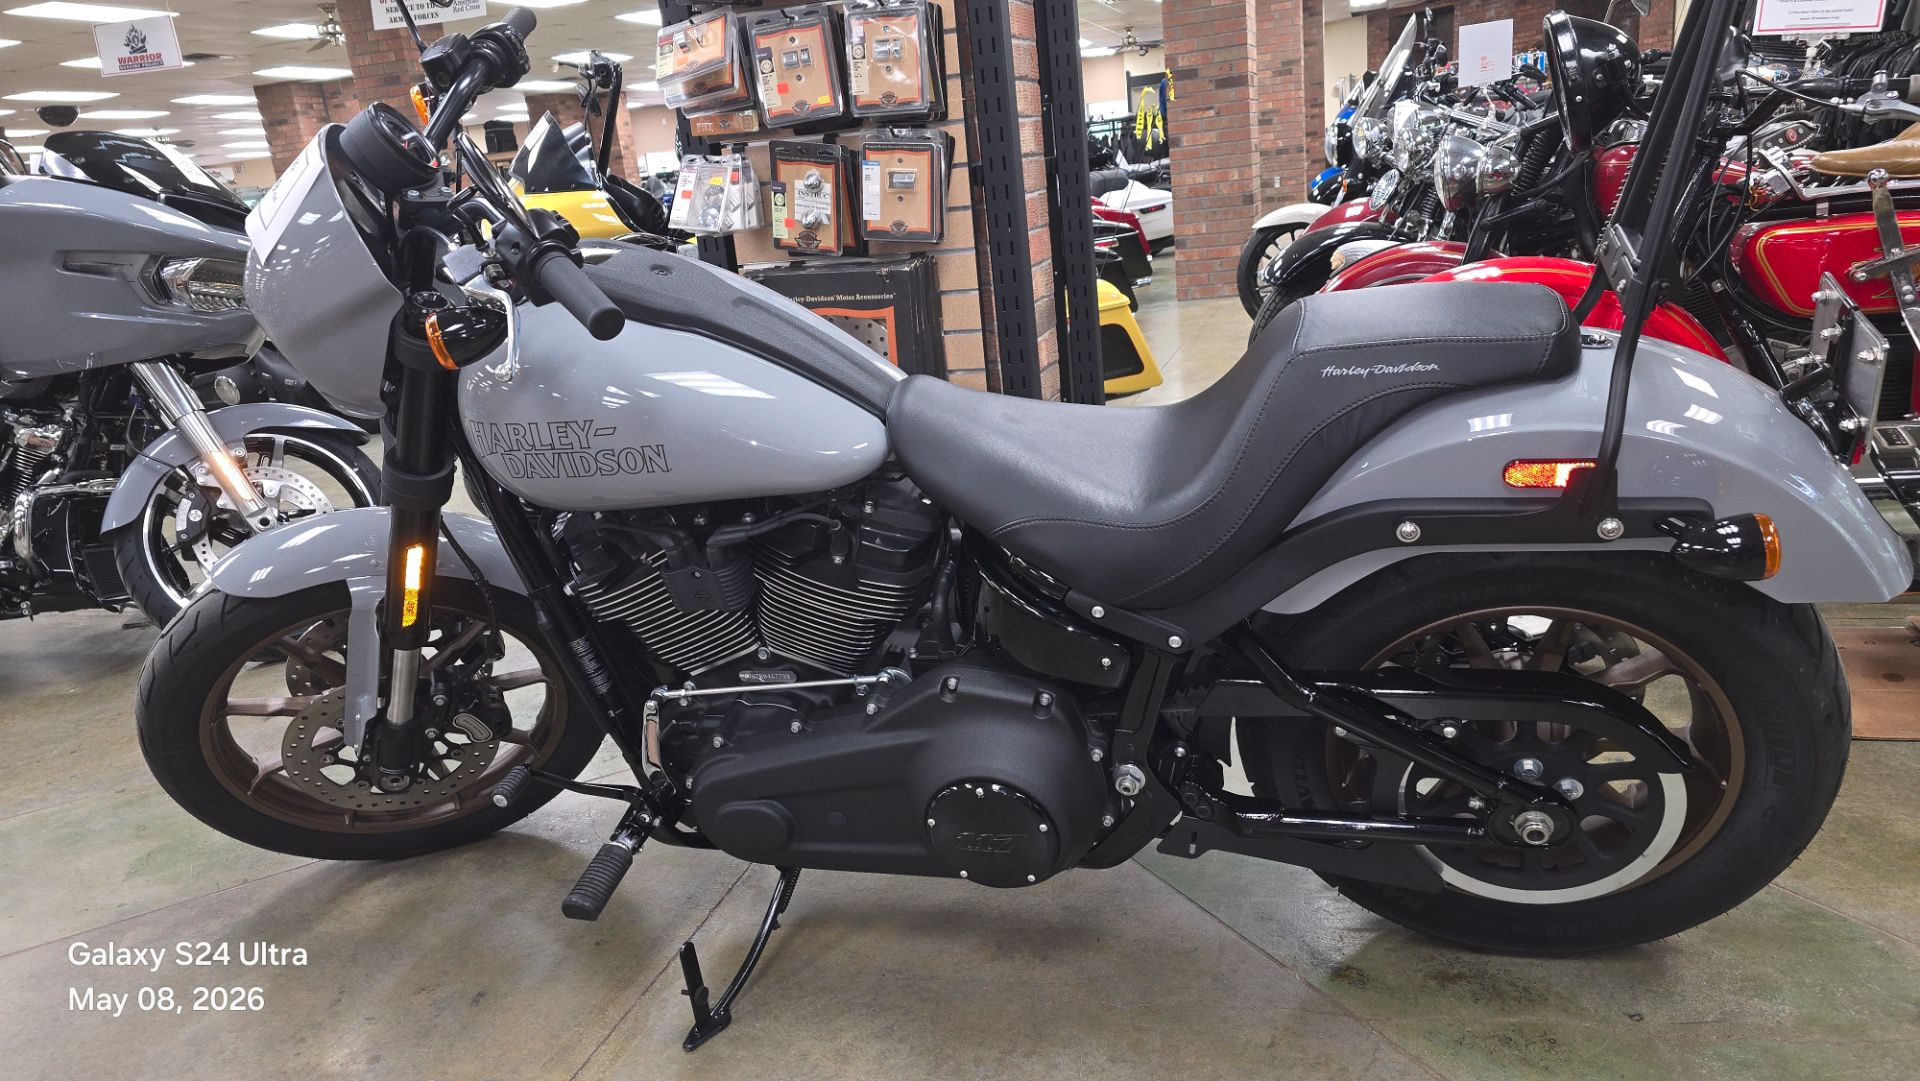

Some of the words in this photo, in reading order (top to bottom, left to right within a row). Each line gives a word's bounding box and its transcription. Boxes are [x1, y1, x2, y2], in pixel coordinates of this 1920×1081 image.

[385, 4, 414, 14] SERCE
[465, 3, 480, 11] Cross
[413, 12, 440, 21] FORCES
[117, 52, 162, 65] WARRIOR
[786, 294, 835, 303] arley-Davidson
[836, 293, 855, 301] Motor
[1321, 361, 1441, 379] Harley-Davidson
[469, 419, 617, 459] HARLEY-
[501, 444, 671, 479] DAVIDSON
